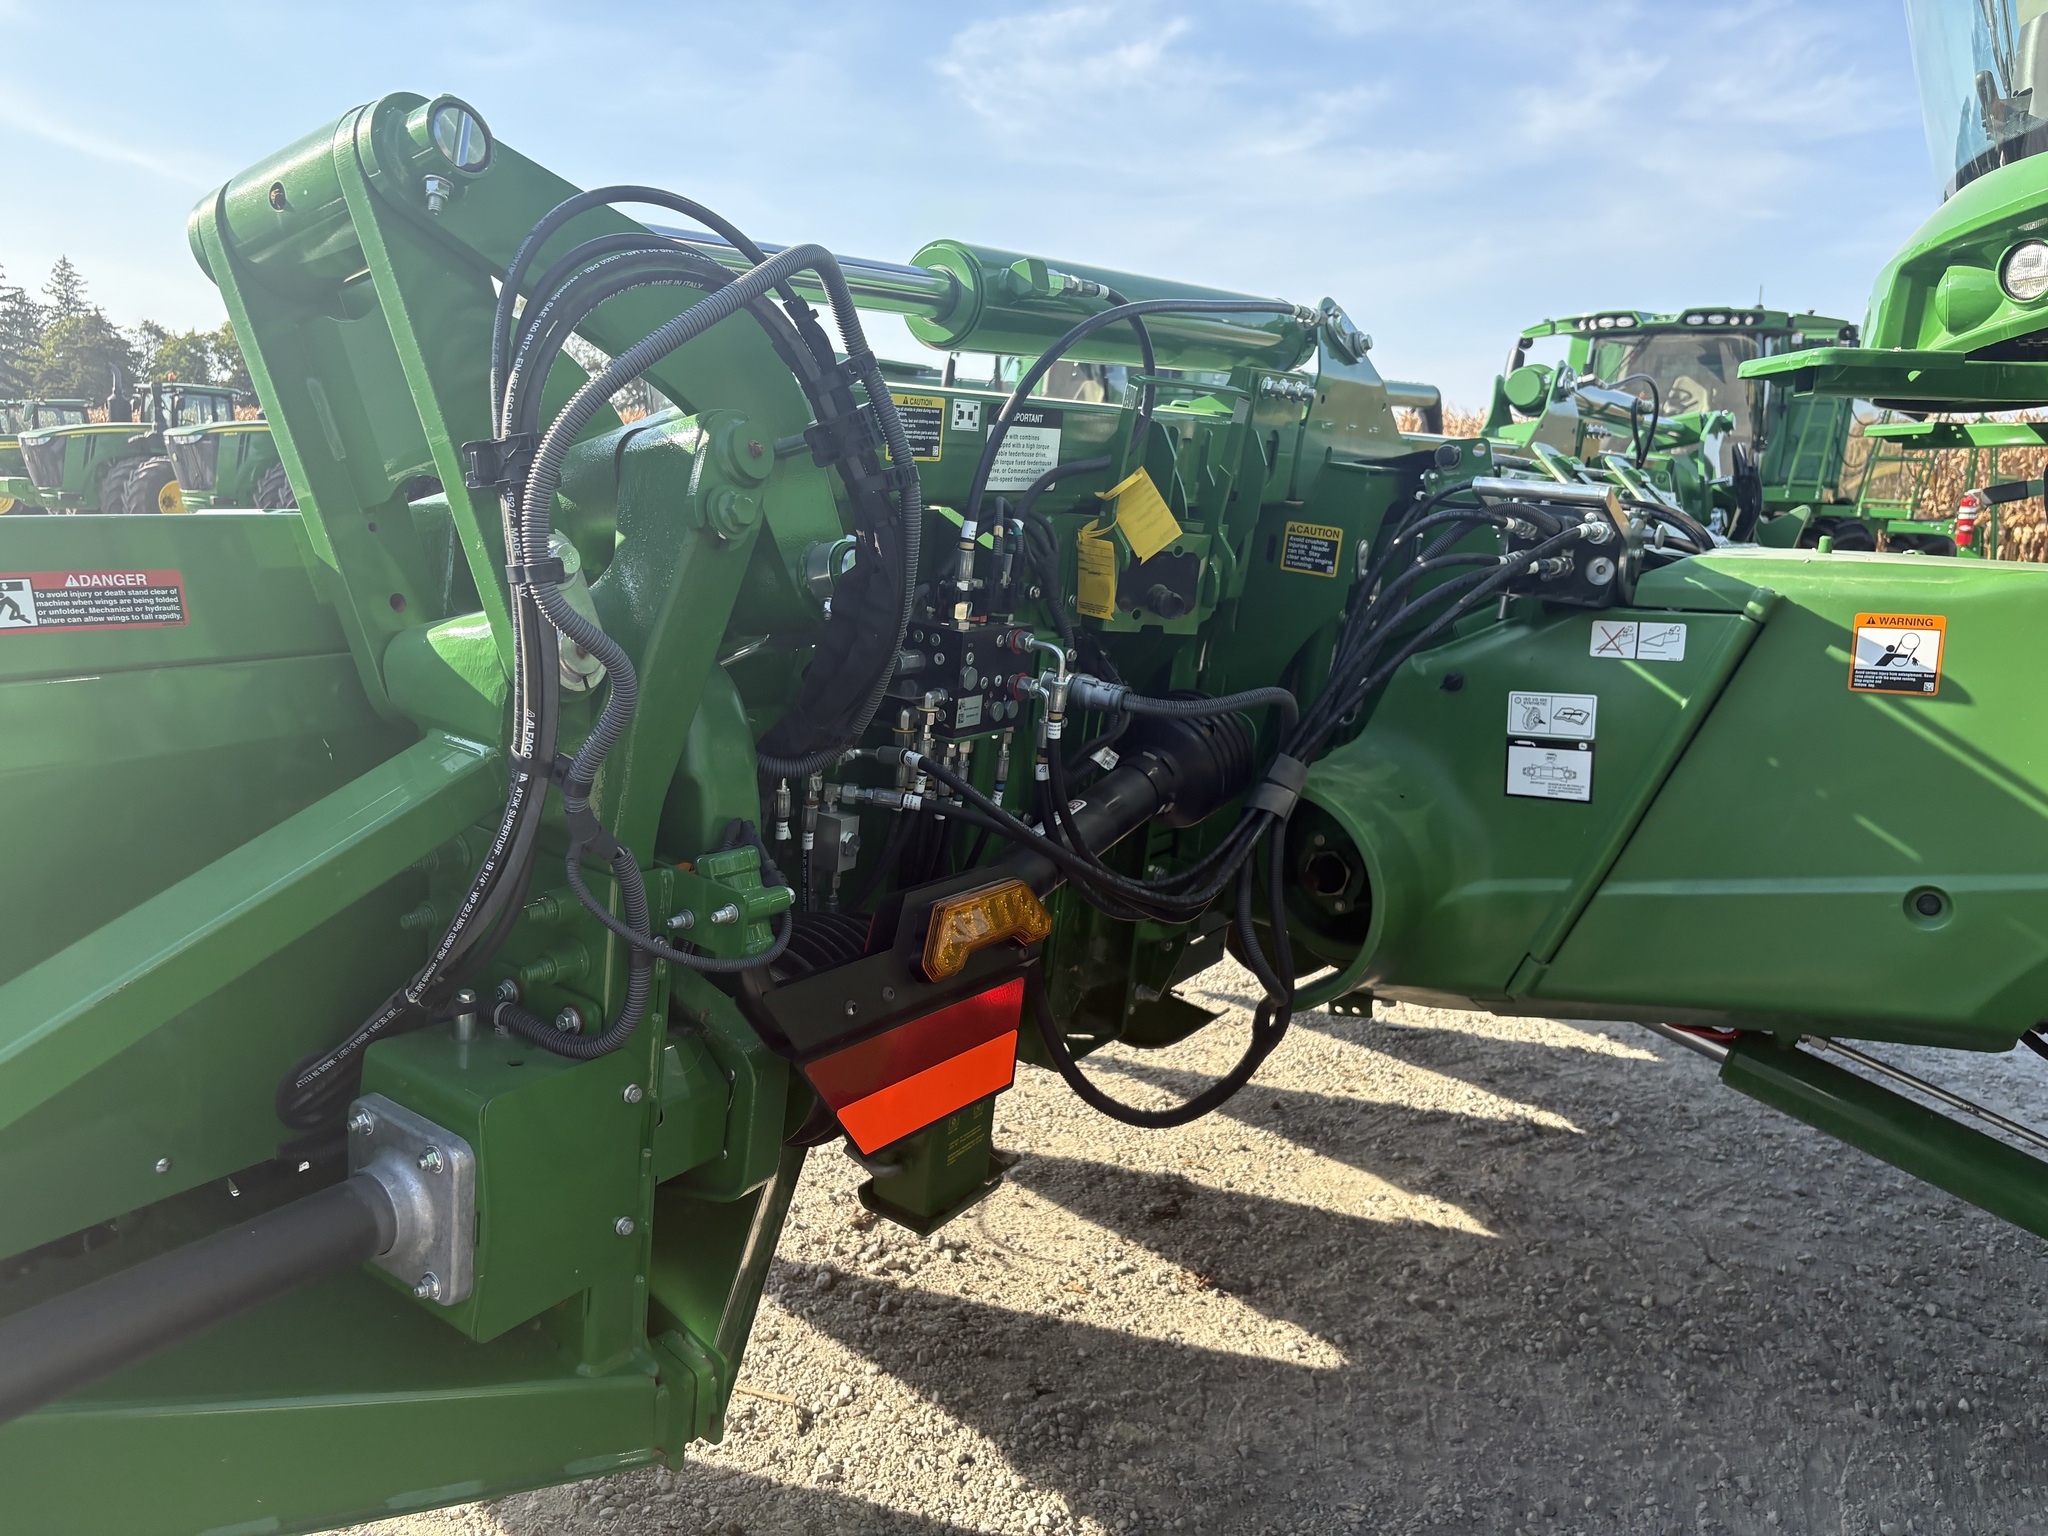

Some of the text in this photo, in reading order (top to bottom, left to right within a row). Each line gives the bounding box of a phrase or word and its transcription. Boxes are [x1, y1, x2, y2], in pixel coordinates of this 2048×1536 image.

[651, 279, 672, 287] MADE
[683, 280, 704, 289] ITALY
[538, 301, 555, 319] SAE
[528, 318, 542, 335] 100
[523, 333, 536, 352] R17
[515, 356, 525, 371] EN
[511, 371, 522, 388] 857
[508, 388, 519, 411] 1SC
[909, 398, 933, 406] CAUTION
[505, 411, 514, 427] DN
[1013, 412, 1044, 424] PORTANT
[1026, 443, 1036, 451] high
[1296, 525, 1340, 539] CAUTION
[511, 527, 523, 557] MADE
[1305, 538, 1329, 547] crushing
[1311, 545, 1330, 553] Header
[1291, 561, 1313, 570] running.
[79, 573, 148, 587] DANGER
[35, 591, 45, 599] To
[47, 591, 69, 599] avoid
[70, 590, 93, 599] injury
[105, 589, 127, 597] death
[150, 588, 169, 596] clear
[519, 583, 529, 599] ALY
[72, 598, 94, 606] when
[95, 598, 119, 607] wings
[133, 597, 155, 605] being
[156, 596, 179, 604] folded
[49, 607, 88, 616] unfolded.
[89, 606, 134, 615] Mechanical
[145, 605, 181, 613] hydraulic
[39, 616, 66, 625] failure
[67, 616, 83, 624] can
[84, 614, 105, 623] allow
[106, 614, 131, 623] wings
[141, 613, 154, 621] fall
[155, 612, 183, 621] rapidly.
[1879, 616, 1934, 627] WARNING
[510, 786, 525, 809] AT3K
[496, 808, 518, 856] SUPERTUFF
[485, 861, 497, 872] 1B
[469, 891, 481, 905] WP
[461, 903, 473, 918] 22.5
[453, 916, 467, 933] MPa
[415, 980, 427, 994] SAE
[318, 1058, 337, 1074] MADE
[312, 1070, 321, 1078] IN
[295, 1074, 314, 1089] ITALY
